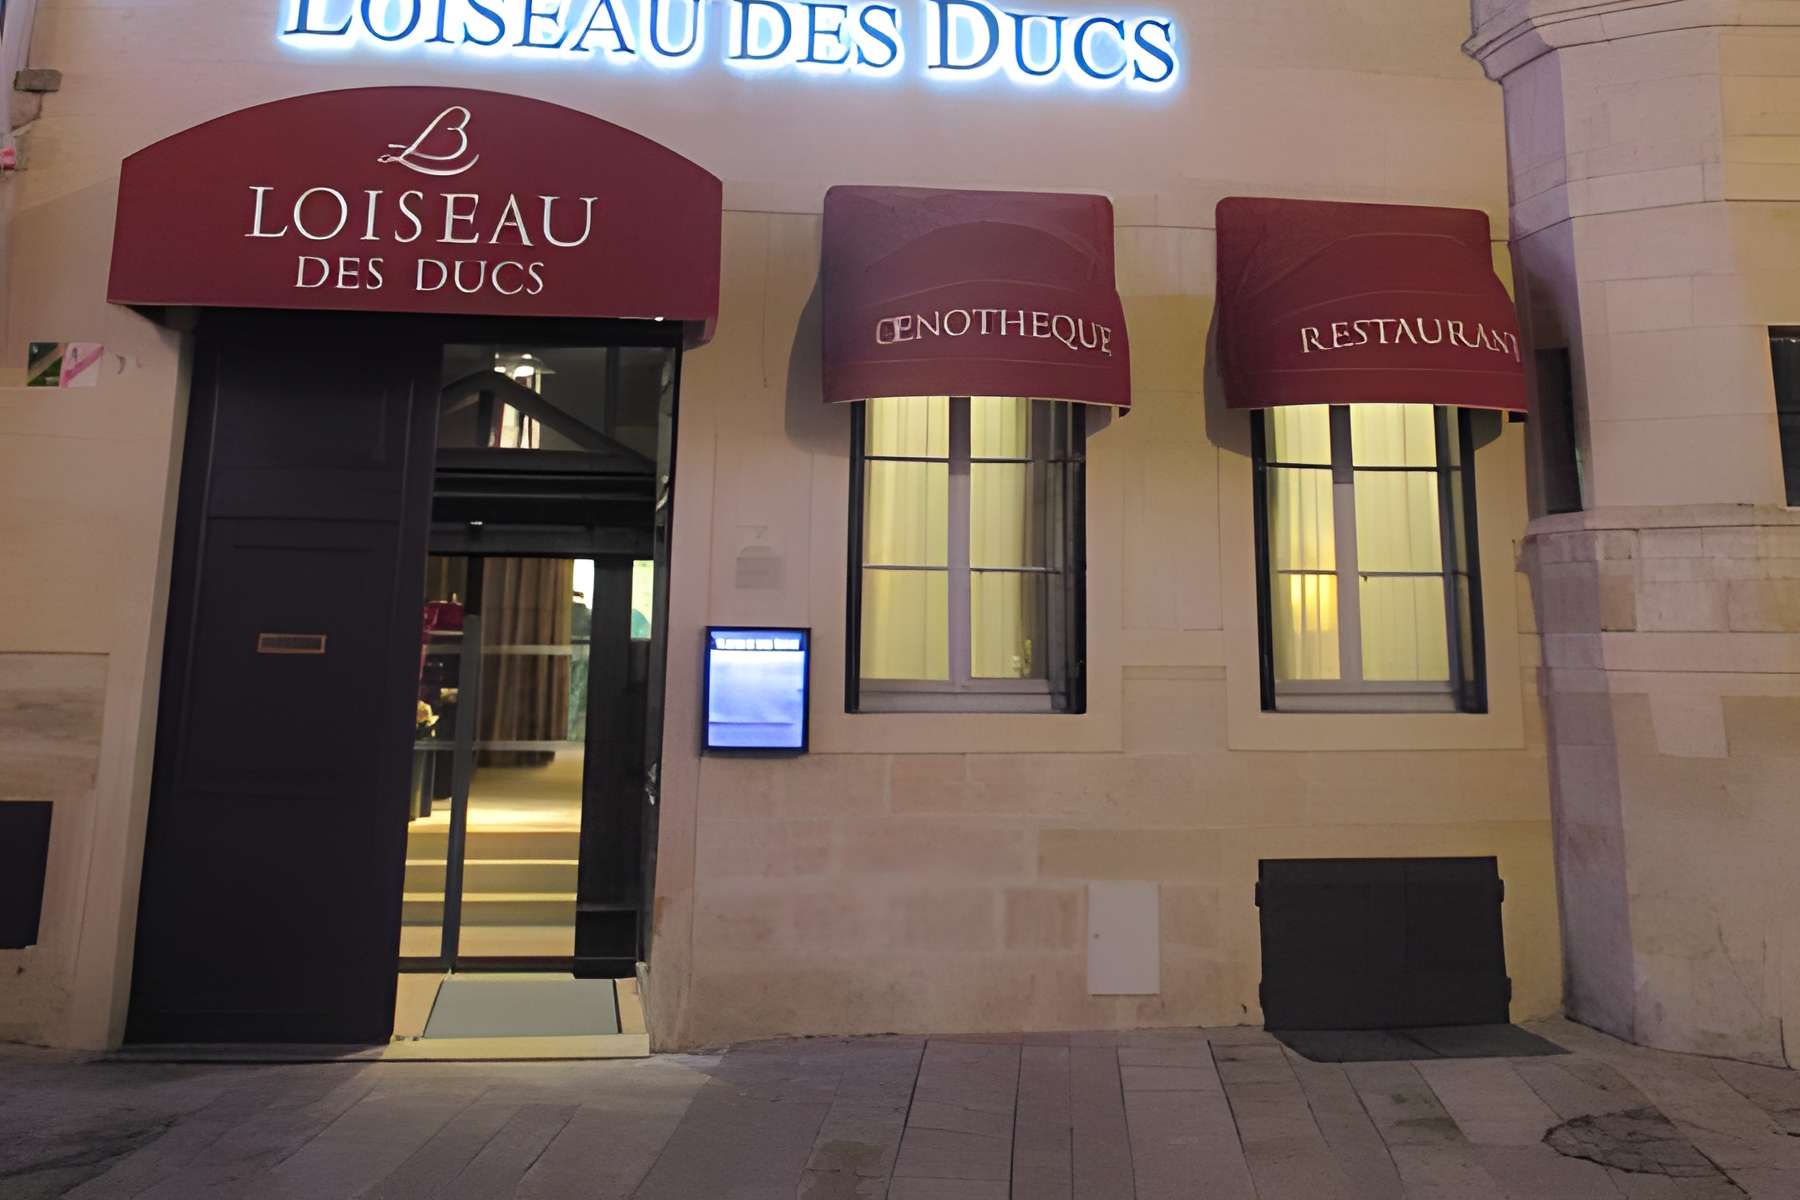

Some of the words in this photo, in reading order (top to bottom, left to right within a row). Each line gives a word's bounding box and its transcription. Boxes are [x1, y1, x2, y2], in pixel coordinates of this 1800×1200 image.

[245, 185, 599, 248] LOISEAU
[294, 255, 385, 290] DES
[415, 258, 545, 296] DUCS
